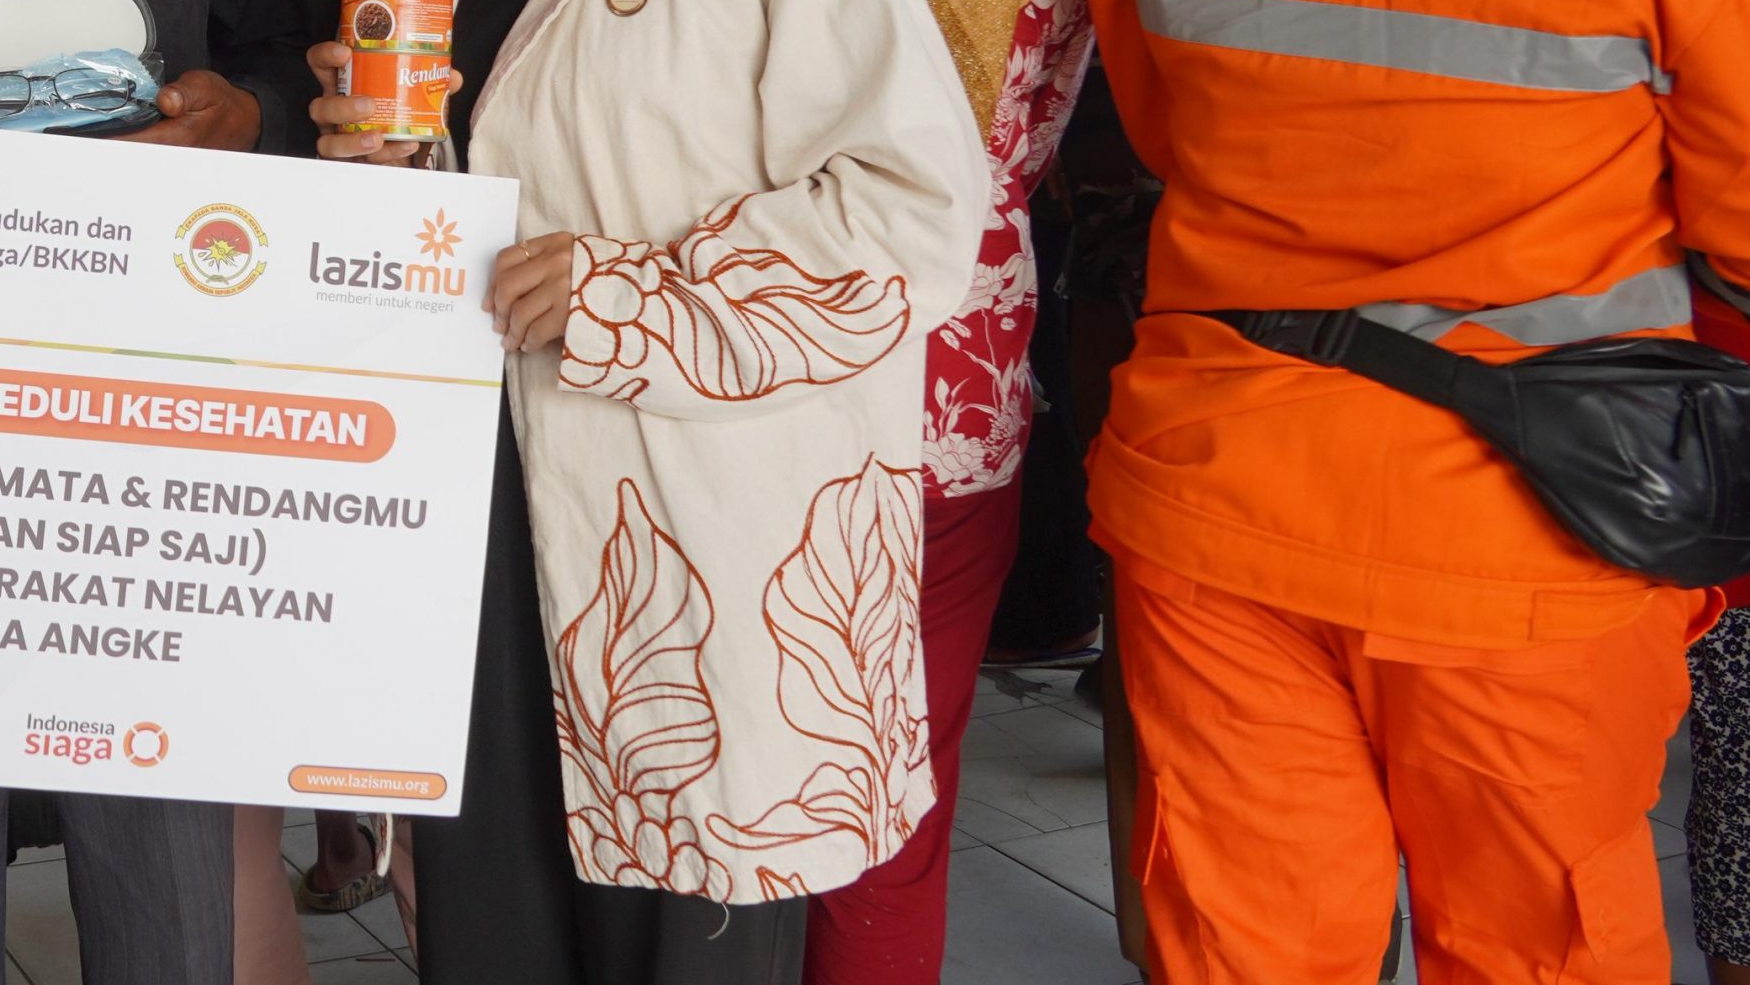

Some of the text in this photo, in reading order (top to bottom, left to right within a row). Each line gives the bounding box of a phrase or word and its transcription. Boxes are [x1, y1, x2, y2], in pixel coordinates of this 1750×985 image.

[86, 216, 132, 242] dan
[309, 242, 466, 296] lazismu
[316, 291, 455, 315] memberi untuk negeri
[120, 393, 368, 447] KESEHATAN
[121, 475, 152, 509] &
[162, 479, 428, 530] RENDANGMU
[56, 521, 150, 558] SIAP
[159, 527, 267, 576] SAJI)
[144, 579, 334, 624] NELAYAN
[37, 622, 183, 662] ANGKE
[26, 713, 116, 735] Indonesia
[24, 732, 114, 766] siaga
[306, 773, 430, 795] www.lazismu.org
